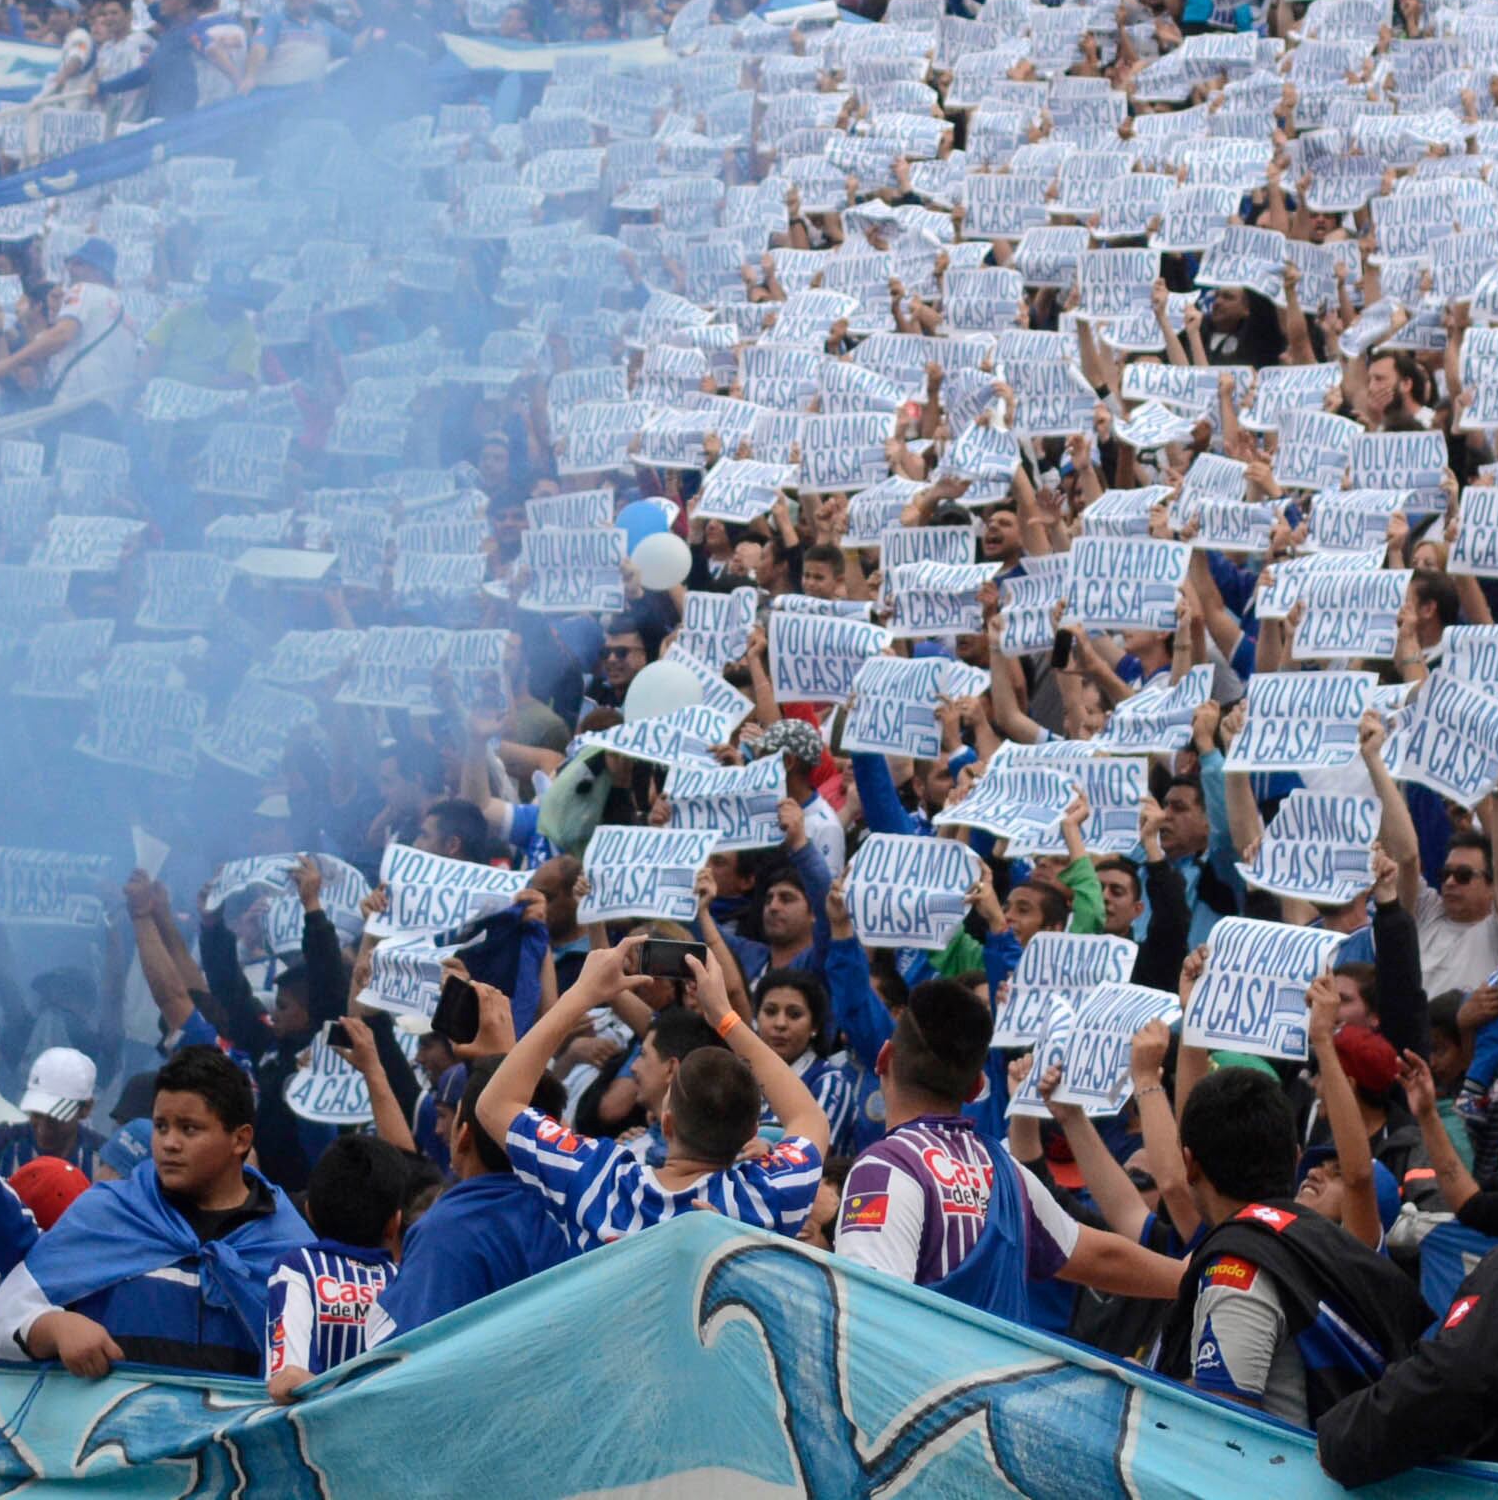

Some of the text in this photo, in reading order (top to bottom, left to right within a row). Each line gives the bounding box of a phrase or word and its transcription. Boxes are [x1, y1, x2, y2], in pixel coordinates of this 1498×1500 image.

[967, 178, 1047, 202] VOLVAMOS
[980, 203, 1022, 232] CASA
[1091, 286, 1132, 316] CASA
[1144, 367, 1196, 397] CASA
[1027, 398, 1071, 427] CASA
[576, 435, 615, 463] CASA
[651, 432, 686, 458] CASA
[804, 418, 889, 447] VOLVAMOS
[813, 450, 861, 483] CASA
[1351, 435, 1443, 469] VOLVAMOS
[1210, 504, 1251, 537] CASA
[1320, 511, 1366, 548] CASA
[527, 535, 621, 566] VOLVAMOS
[884, 530, 970, 565] VOLVAMOS
[1073, 542, 1184, 581] VOLVAMOS
[1454, 535, 1467, 561] A
[529, 571, 592, 601] A CASA
[1067, 582, 1142, 619] A CASA
[1309, 573, 1403, 610] VOLVAMOS
[909, 594, 962, 625] CASA
[775, 616, 889, 657] VOLVAMOS
[1314, 614, 1369, 650] CASA
[778, 654, 854, 692] A CASA
[853, 657, 943, 699] VOLVAMOS
[1249, 677, 1369, 719] VOLVAMOS
[858, 701, 902, 742] CASA
[1233, 723, 1322, 761] A CASA
[1405, 722, 1488, 794] A CASA
[589, 830, 716, 866] VOLVAMOS
[852, 838, 974, 889] VOLVAMOS
[1268, 842, 1335, 889] CASA
[388, 850, 534, 893] VOLVAMOS
[598, 866, 659, 912] CASA
[378, 884, 468, 929] A CASA
[862, 884, 931, 934] CASA
[1209, 922, 1331, 982] VOLVAMOS
[1001, 988, 1019, 1030] A
[1189, 973, 1271, 1037] A CASA
[1070, 1035, 1120, 1089] CASA
[292, 1078, 310, 1099] A
[331, 1303, 351, 1316] de
